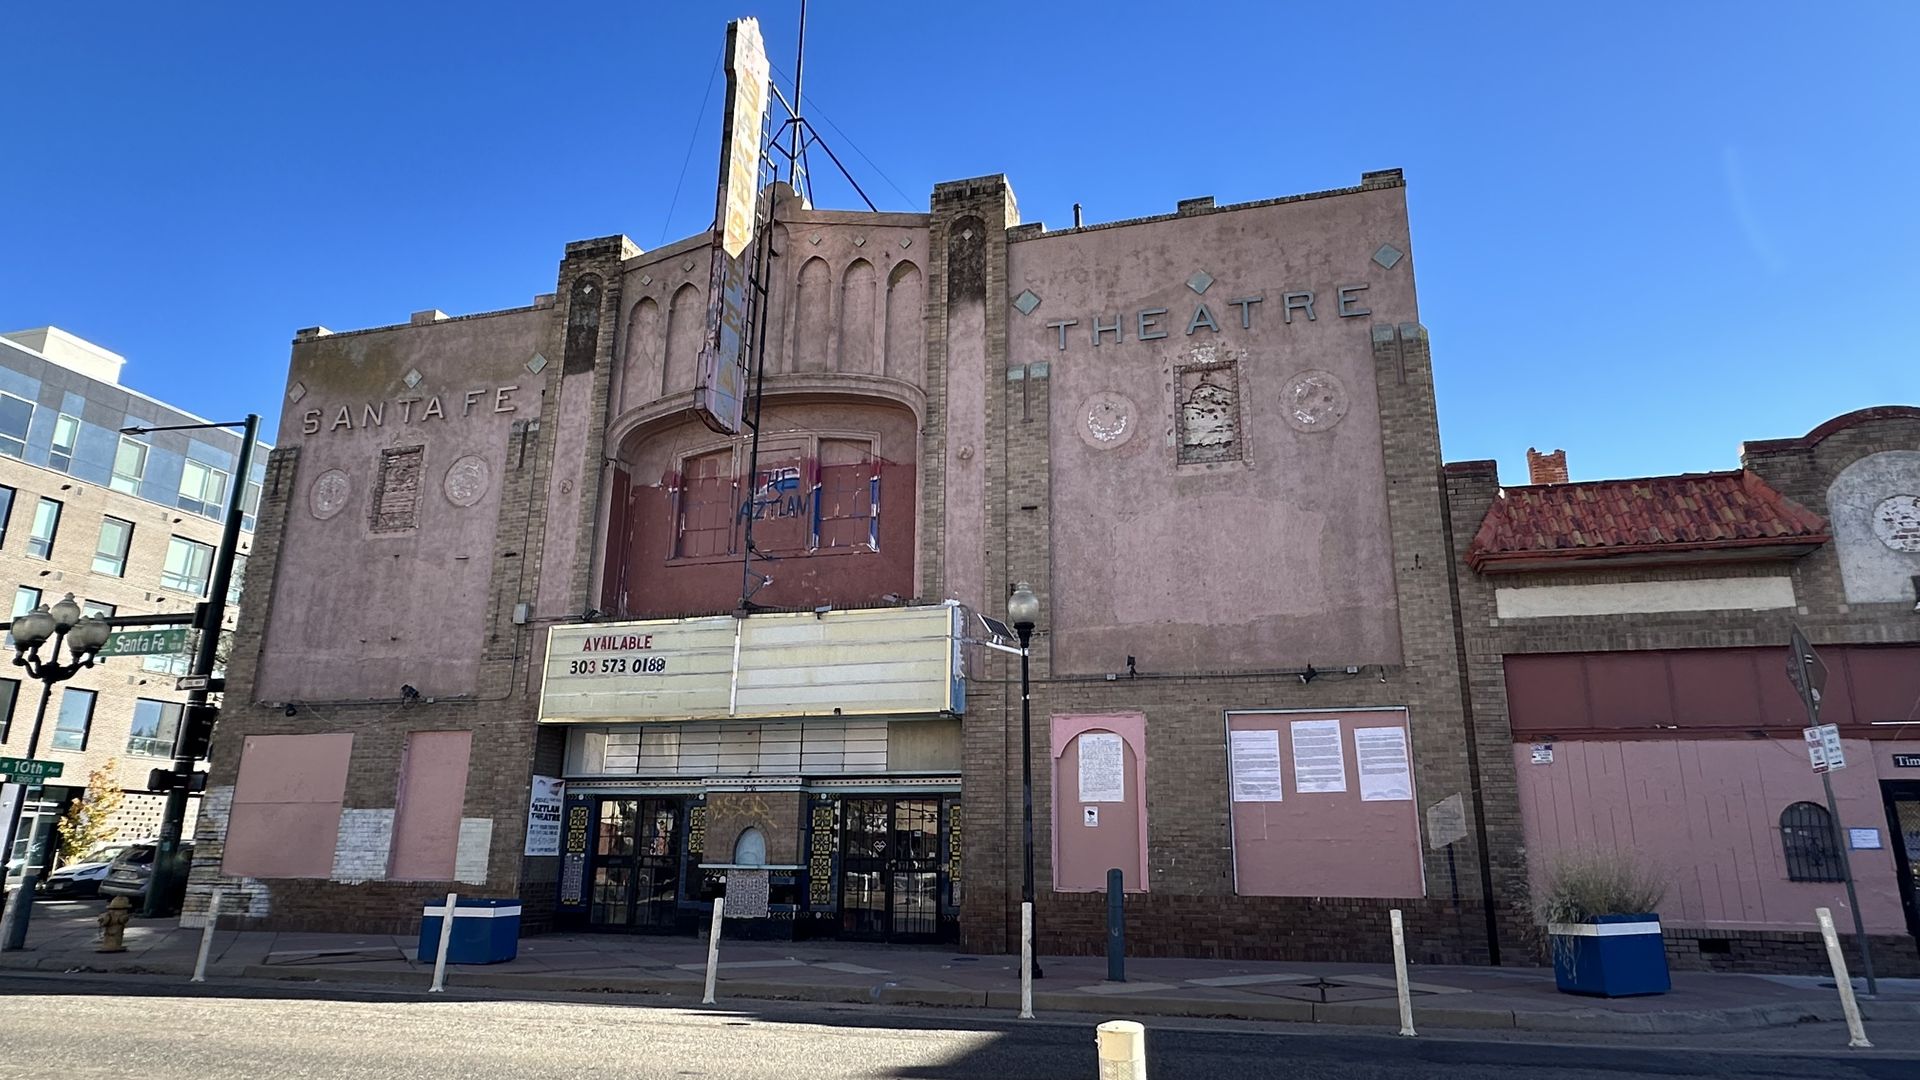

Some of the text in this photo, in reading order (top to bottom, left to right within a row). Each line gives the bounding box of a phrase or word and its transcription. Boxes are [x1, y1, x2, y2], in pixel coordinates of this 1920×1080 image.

[1046, 283, 1372, 350] THEATRE
[302, 385, 519, 435] SANTA FE
[114, 634, 149, 654] Santa
[151, 632, 165, 652] Fe
[583, 635, 653, 651] AVAILABLE
[570, 660, 597, 674] 303
[601, 658, 626, 673] 573
[14, 760, 43, 774] 10th
